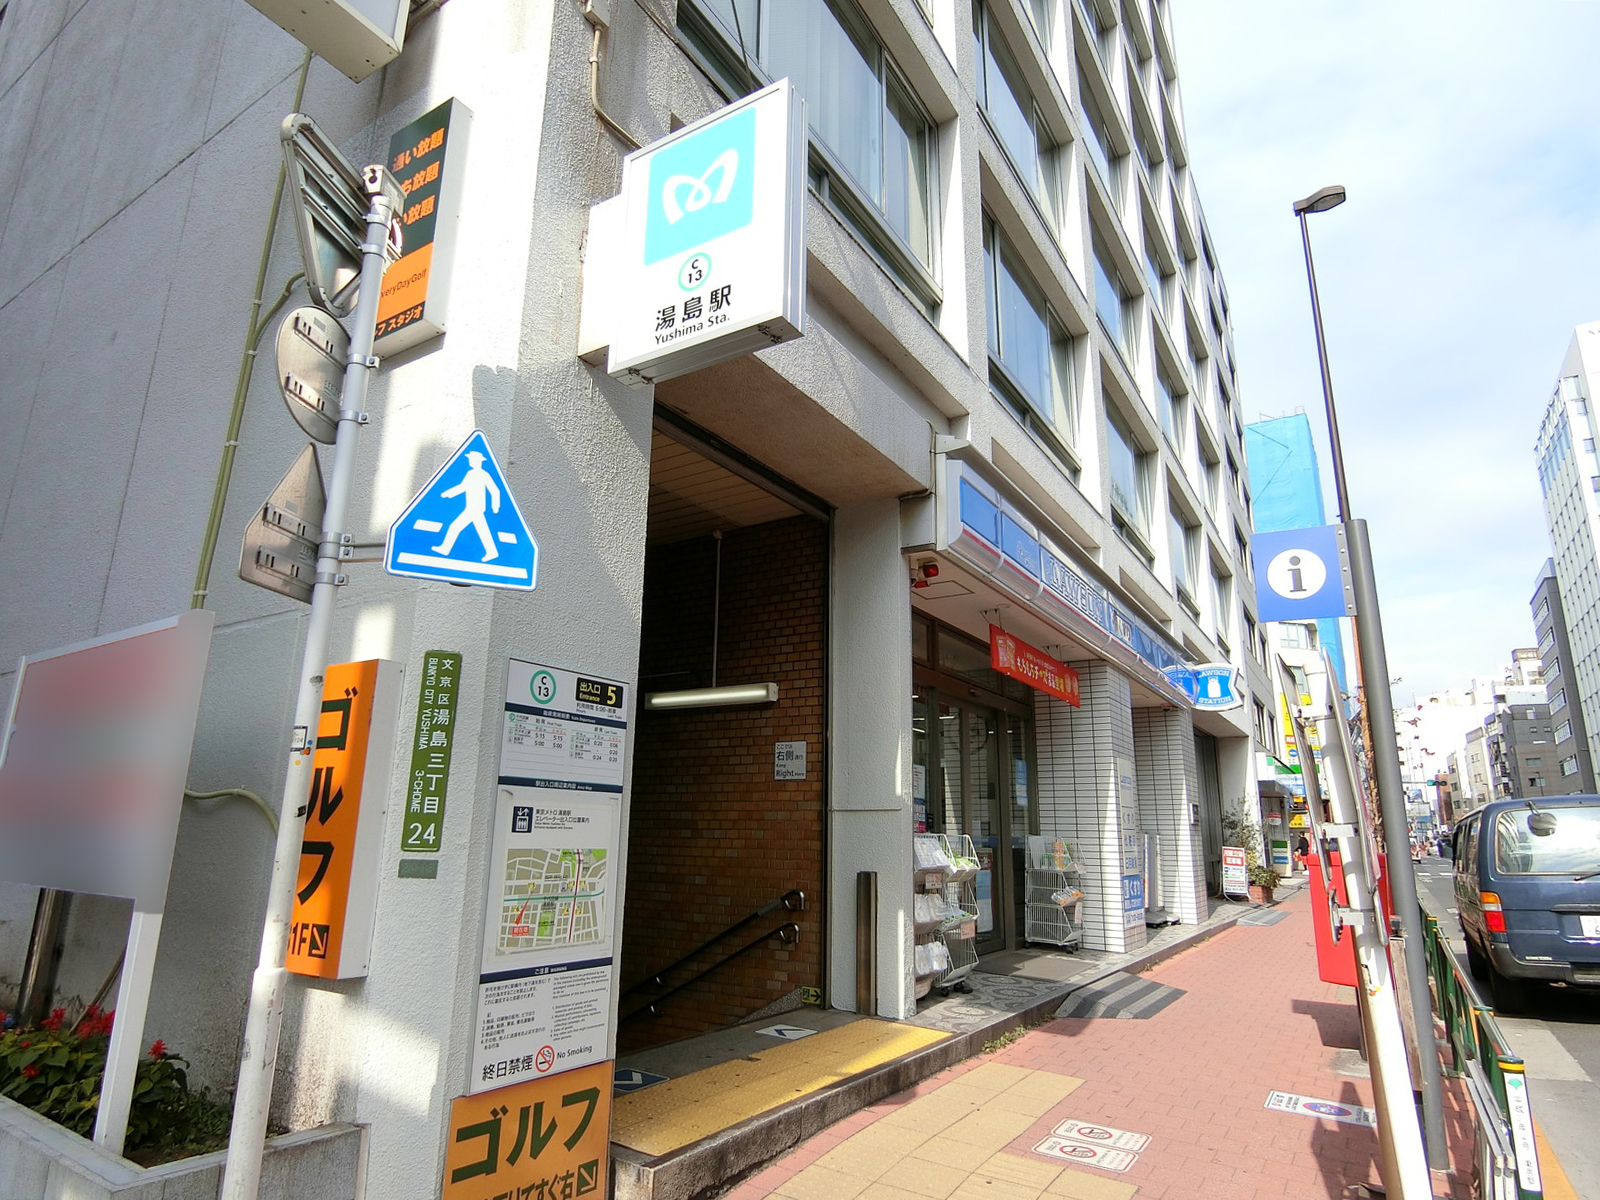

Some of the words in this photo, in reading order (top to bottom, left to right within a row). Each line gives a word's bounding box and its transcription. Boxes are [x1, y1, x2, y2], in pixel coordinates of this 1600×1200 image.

[401, 160, 440, 195] ち放題
[691, 258, 699, 270] C
[381, 268, 427, 298] veryDayGolf
[688, 269, 703, 284] 13
[655, 284, 731, 332] 湯島駅
[655, 322, 704, 345] Yushima
[707, 313, 731, 328] Sta.
[426, 657, 439, 686] BUNKYO
[541, 675, 548, 686] C
[1196, 669, 1230, 679] LAWSON
[423, 688, 435, 705] CITY
[537, 685, 550, 698] 13
[578, 692, 601, 703] Entrance
[579, 681, 601, 695] 出入口
[606, 686, 618, 705] 5
[1198, 695, 1233, 706] STATION
[418, 708, 433, 750] YUSHIMA
[776, 769, 794, 779] Right
[297, 686, 358, 906] ゴルフ
[410, 769, 425, 813] 3-CHOME
[407, 822, 436, 845] 24
[556, 1050, 566, 1060] No
[567, 1045, 593, 1058] Smoking
[481, 1054, 534, 1082] 終日禁煙
[451, 1086, 601, 1184] ゴルフ
